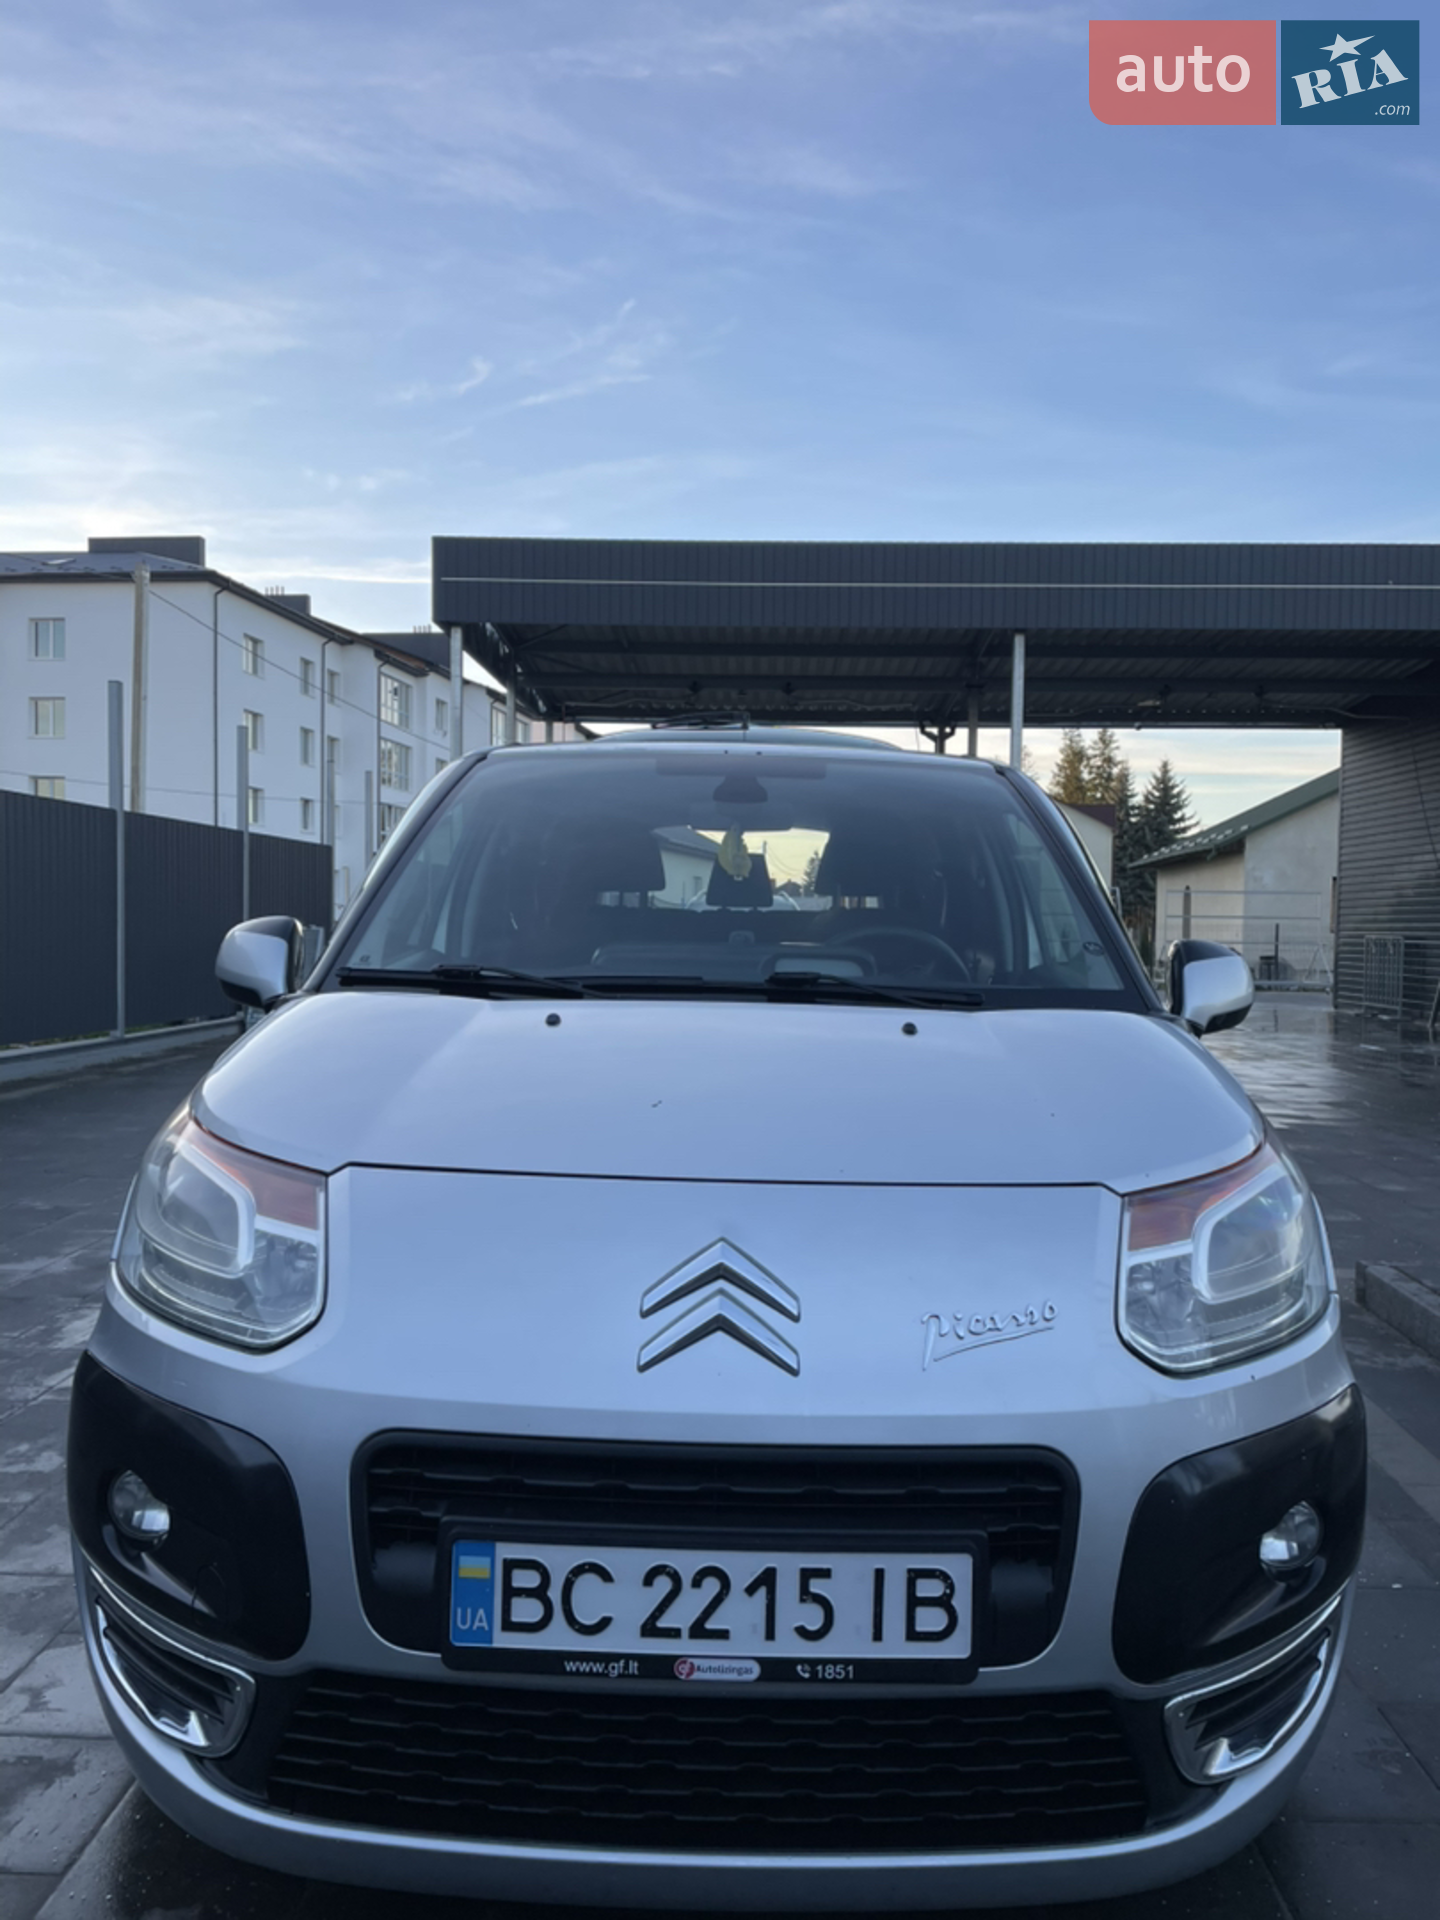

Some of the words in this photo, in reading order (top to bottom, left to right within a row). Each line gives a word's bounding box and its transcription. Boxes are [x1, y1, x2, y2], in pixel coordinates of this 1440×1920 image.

[501, 1557, 615, 1636] BC
[639, 1564, 835, 1642] 2215
[871, 1566, 960, 1642] IB
[456, 1606, 489, 1631] UA
[564, 1659, 640, 1677] www.gf.lt
[815, 1663, 854, 1679] 1851
